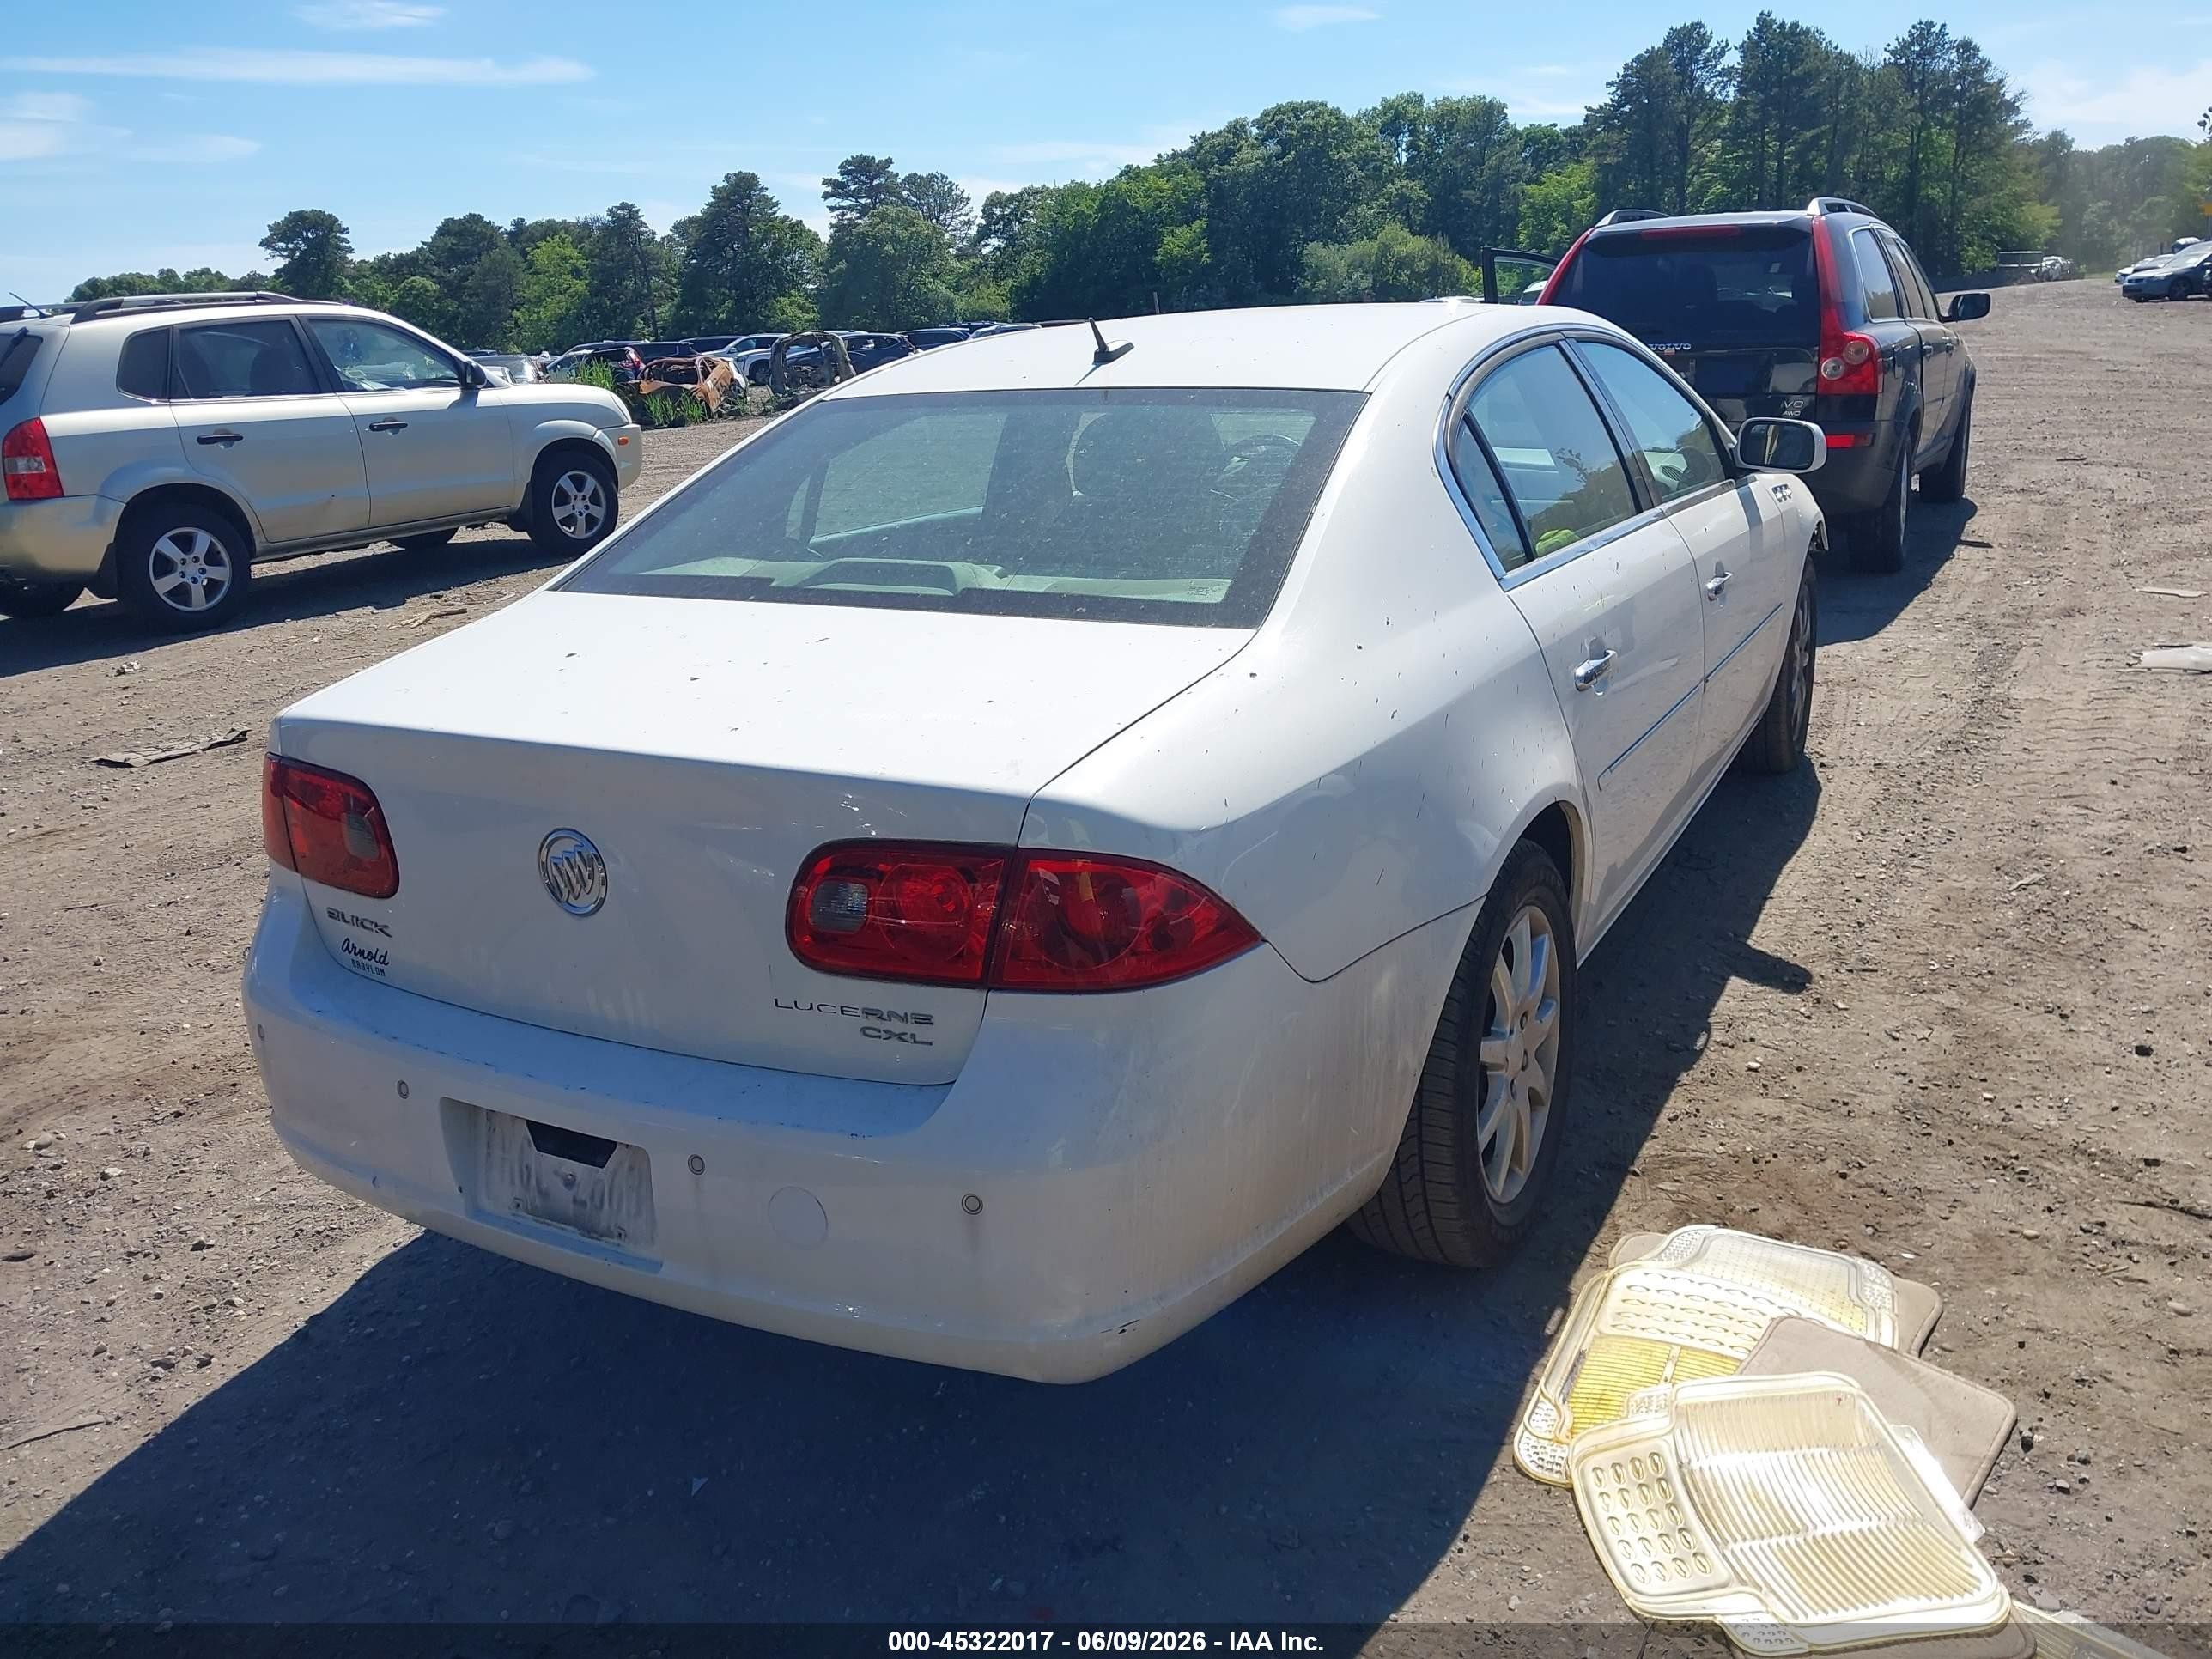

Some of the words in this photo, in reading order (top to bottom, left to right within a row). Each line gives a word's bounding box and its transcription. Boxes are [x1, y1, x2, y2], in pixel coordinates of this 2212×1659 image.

[1648, 343, 1692, 351] VOLVO
[1784, 400, 1804, 409] V8
[326, 907, 392, 939] BUICK
[341, 937, 390, 966] Arnold
[774, 998, 934, 1026] LUCERNE
[860, 1026, 933, 1047] CXL
